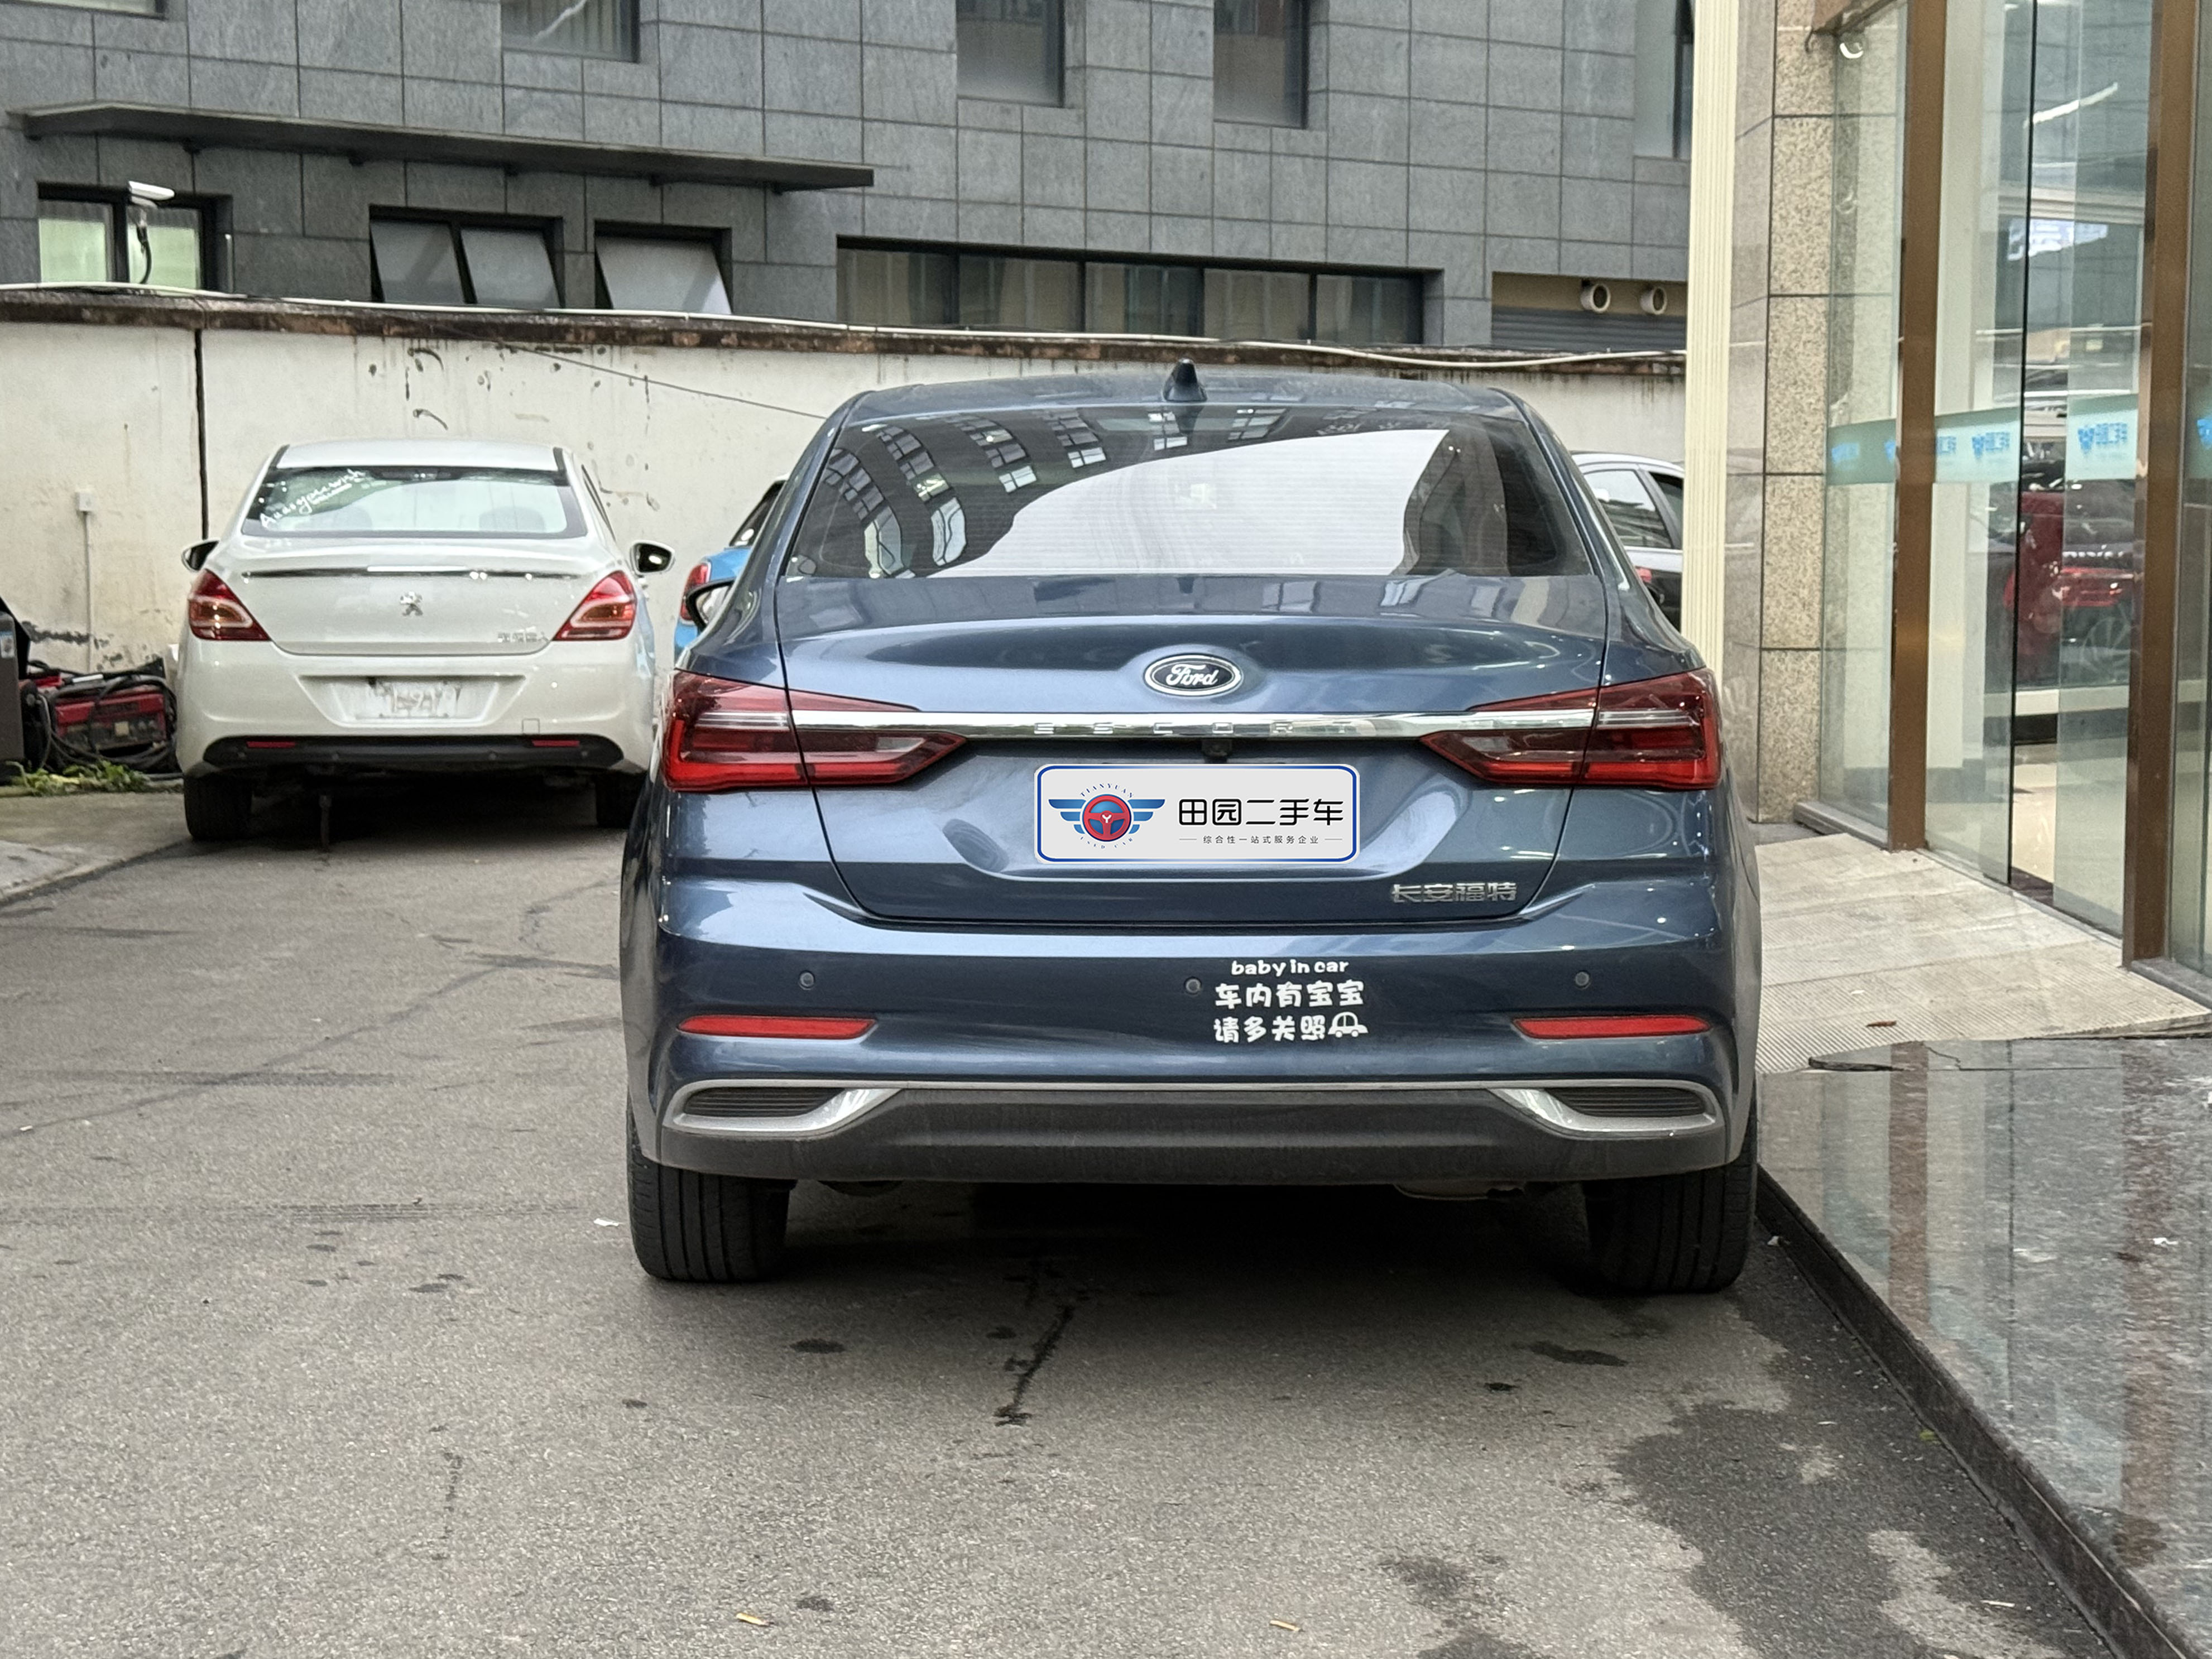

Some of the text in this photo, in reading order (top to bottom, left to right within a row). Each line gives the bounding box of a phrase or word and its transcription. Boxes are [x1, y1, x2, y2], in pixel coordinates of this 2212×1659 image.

[1165, 663, 1220, 686] Ford
[1033, 720, 1356, 735] ESCORT
[1392, 882, 1517, 903] 长安福特
[1231, 959, 1349, 977] baby in car
[1215, 979, 1364, 1009] 车内有宝宝
[1213, 1014, 1326, 1043] 请多关照
